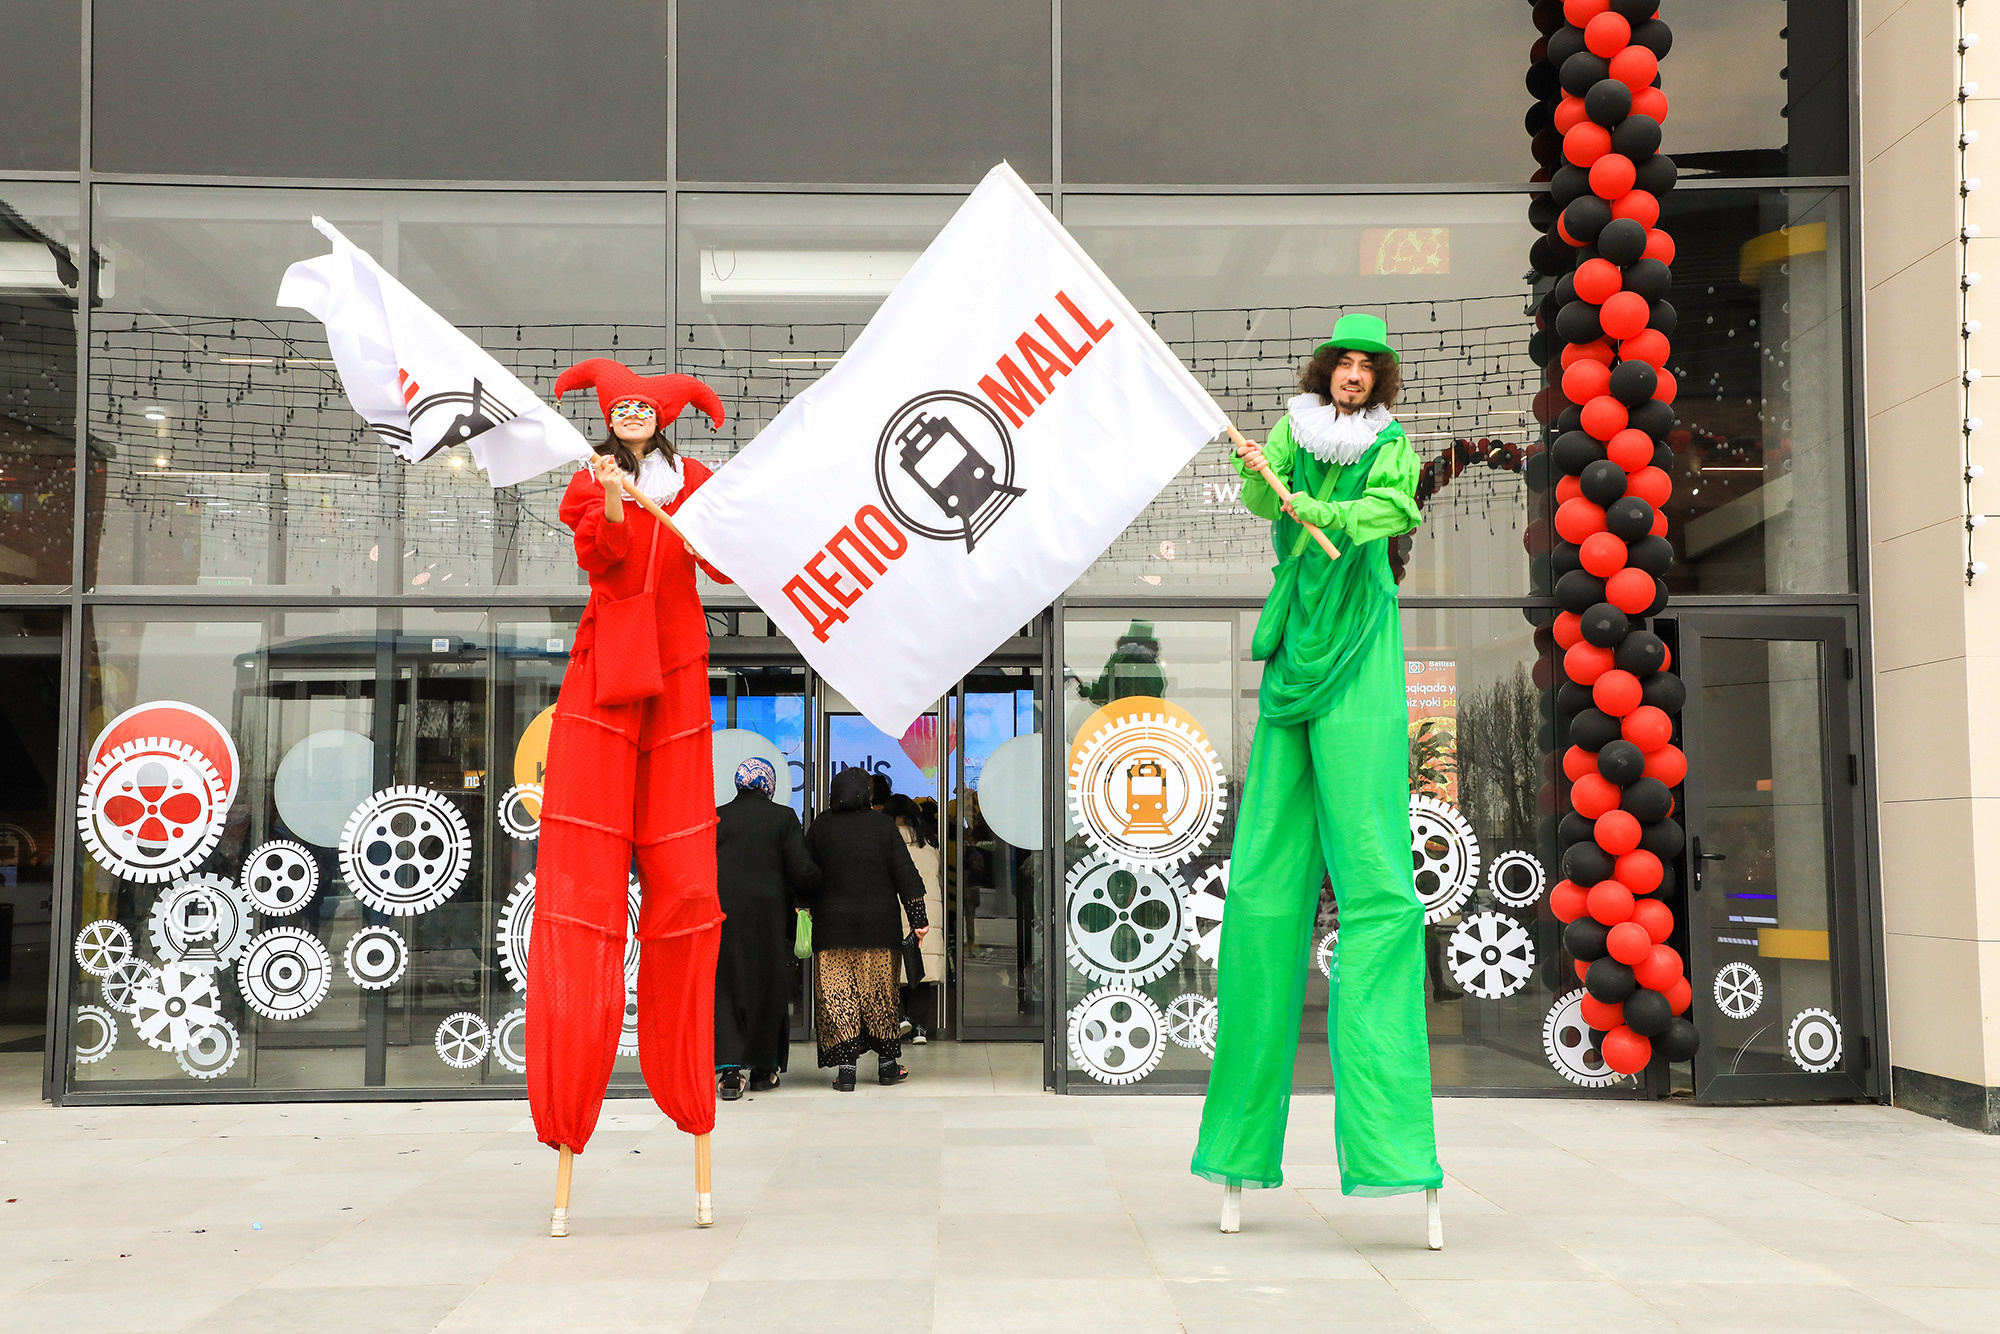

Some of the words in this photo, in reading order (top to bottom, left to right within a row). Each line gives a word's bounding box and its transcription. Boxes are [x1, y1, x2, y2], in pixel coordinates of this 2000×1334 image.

[978, 290, 1114, 430] MALL
[781, 504, 908, 643] ДЕПО
[1419, 697, 1441, 709] yoki
